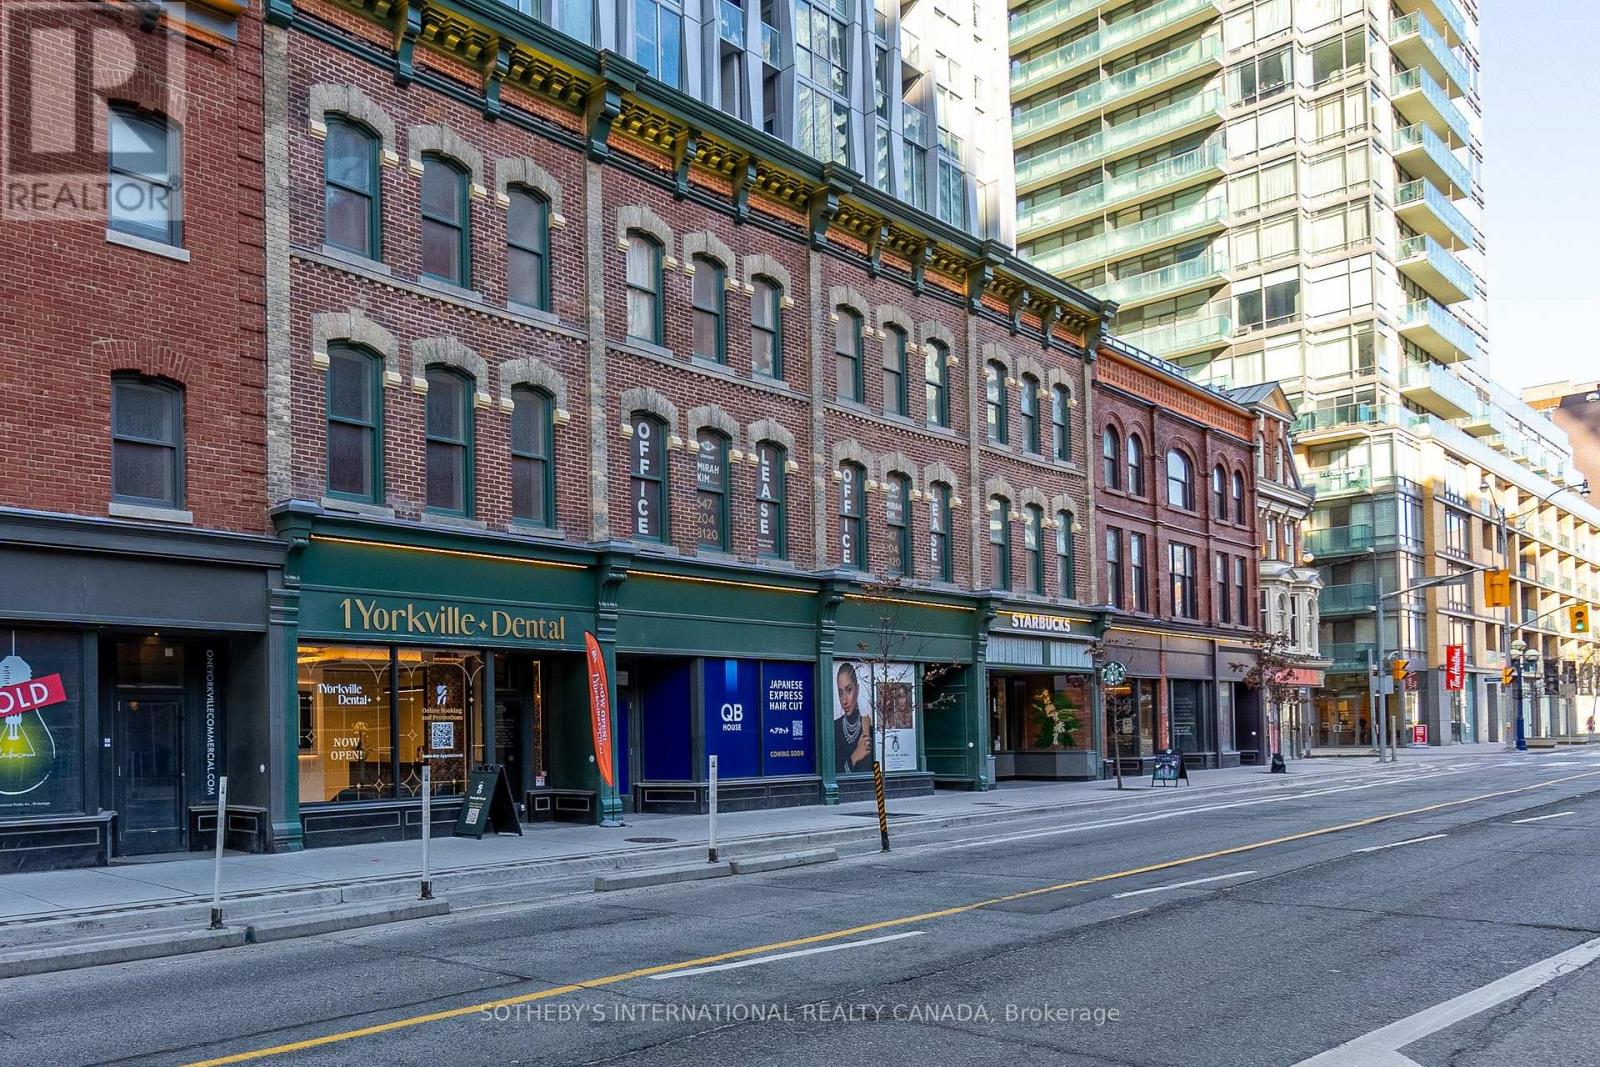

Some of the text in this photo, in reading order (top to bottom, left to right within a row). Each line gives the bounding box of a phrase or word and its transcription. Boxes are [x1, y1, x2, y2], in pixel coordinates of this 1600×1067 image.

[697, 461, 720, 475] MIRAH
[637, 421, 651, 535] OFFICE
[697, 473, 710, 484] KIM
[760, 448, 771, 535] LEASE
[842, 468, 852, 564] OFFICE
[930, 488, 940, 562] LEASE
[339, 598, 566, 641] 1Yorkville Dental
[1011, 613, 1072, 633] STARBUCKS
[769, 679, 804, 690] JAPANESE
[337, 694, 368, 705] Dental
[769, 690, 804, 701] EXPRESS
[721, 703, 743, 722] QB
[769, 701, 804, 711] HAIR CUT
[206, 649, 216, 796] ONEYORKVILLECOMMERCIAL.COM
[722, 723, 742, 731] HOUSE
[333, 737, 361, 748] NOW
[330, 750, 363, 761] OPEN!
